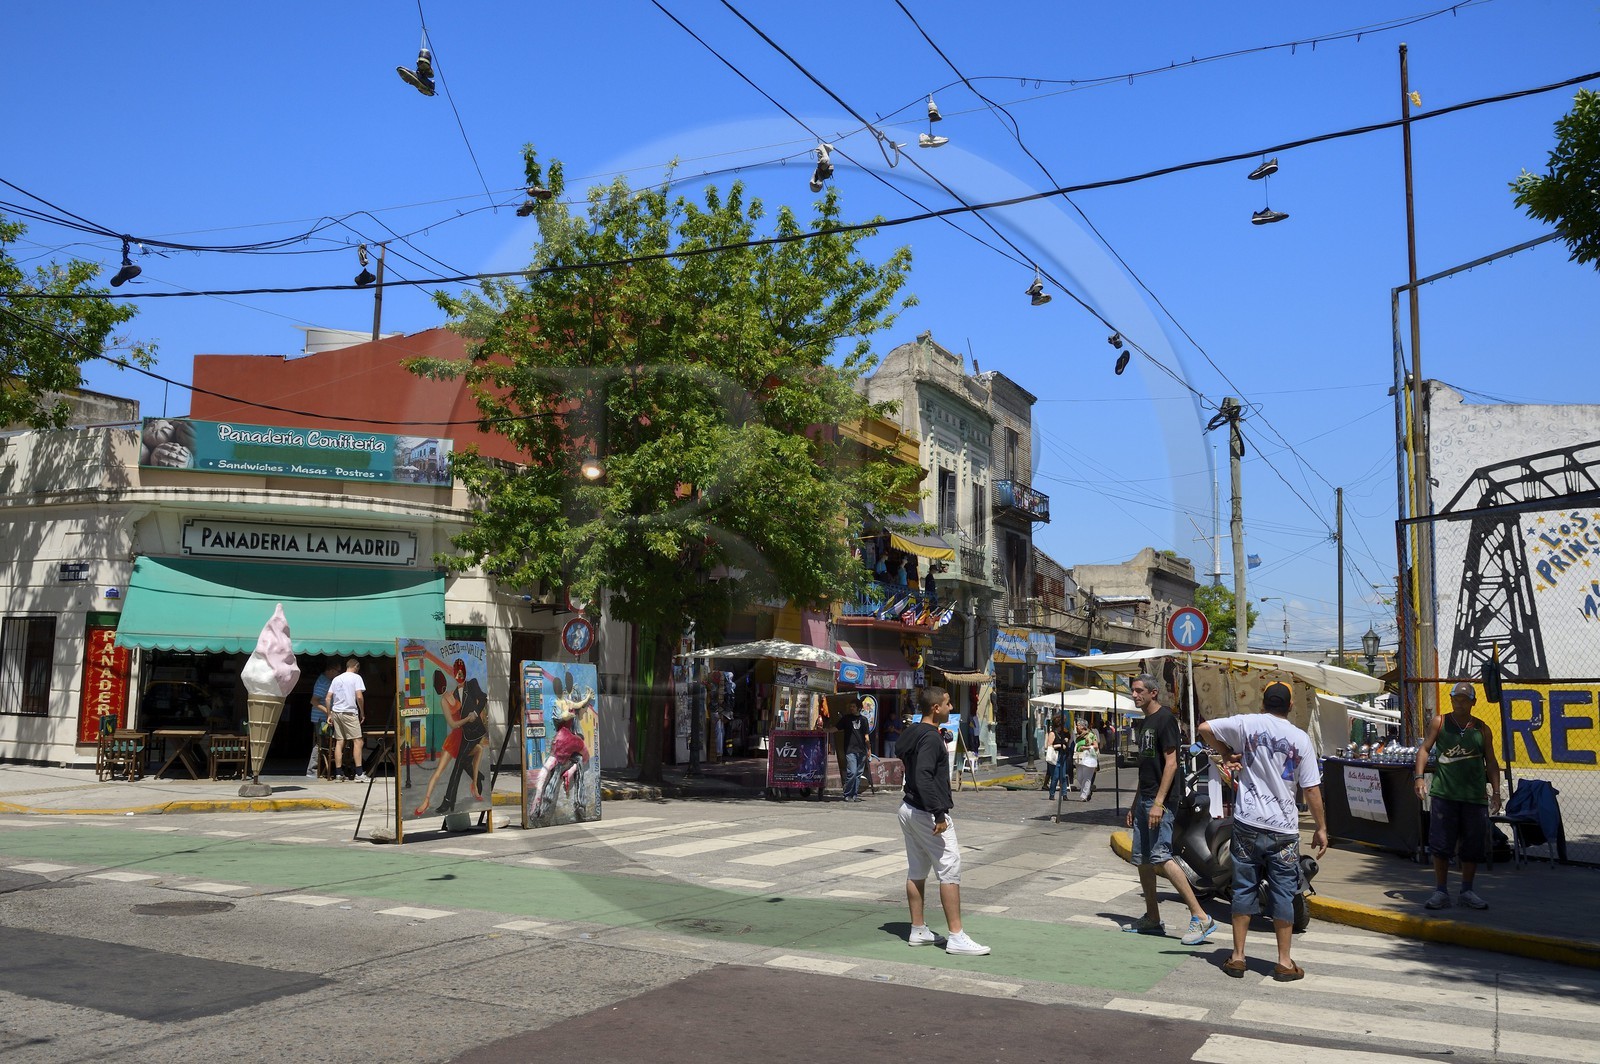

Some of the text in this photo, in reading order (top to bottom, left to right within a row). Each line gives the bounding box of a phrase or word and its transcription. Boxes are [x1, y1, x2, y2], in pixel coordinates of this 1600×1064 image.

[218, 460, 375, 479] Sandwiches Masas Postres
[201, 526, 401, 558] PANADERIA LA MADRID
[1539, 511, 1588, 551] LOS
[401, 707, 429, 717] CAMINITO
[1500, 689, 1600, 765] RE
